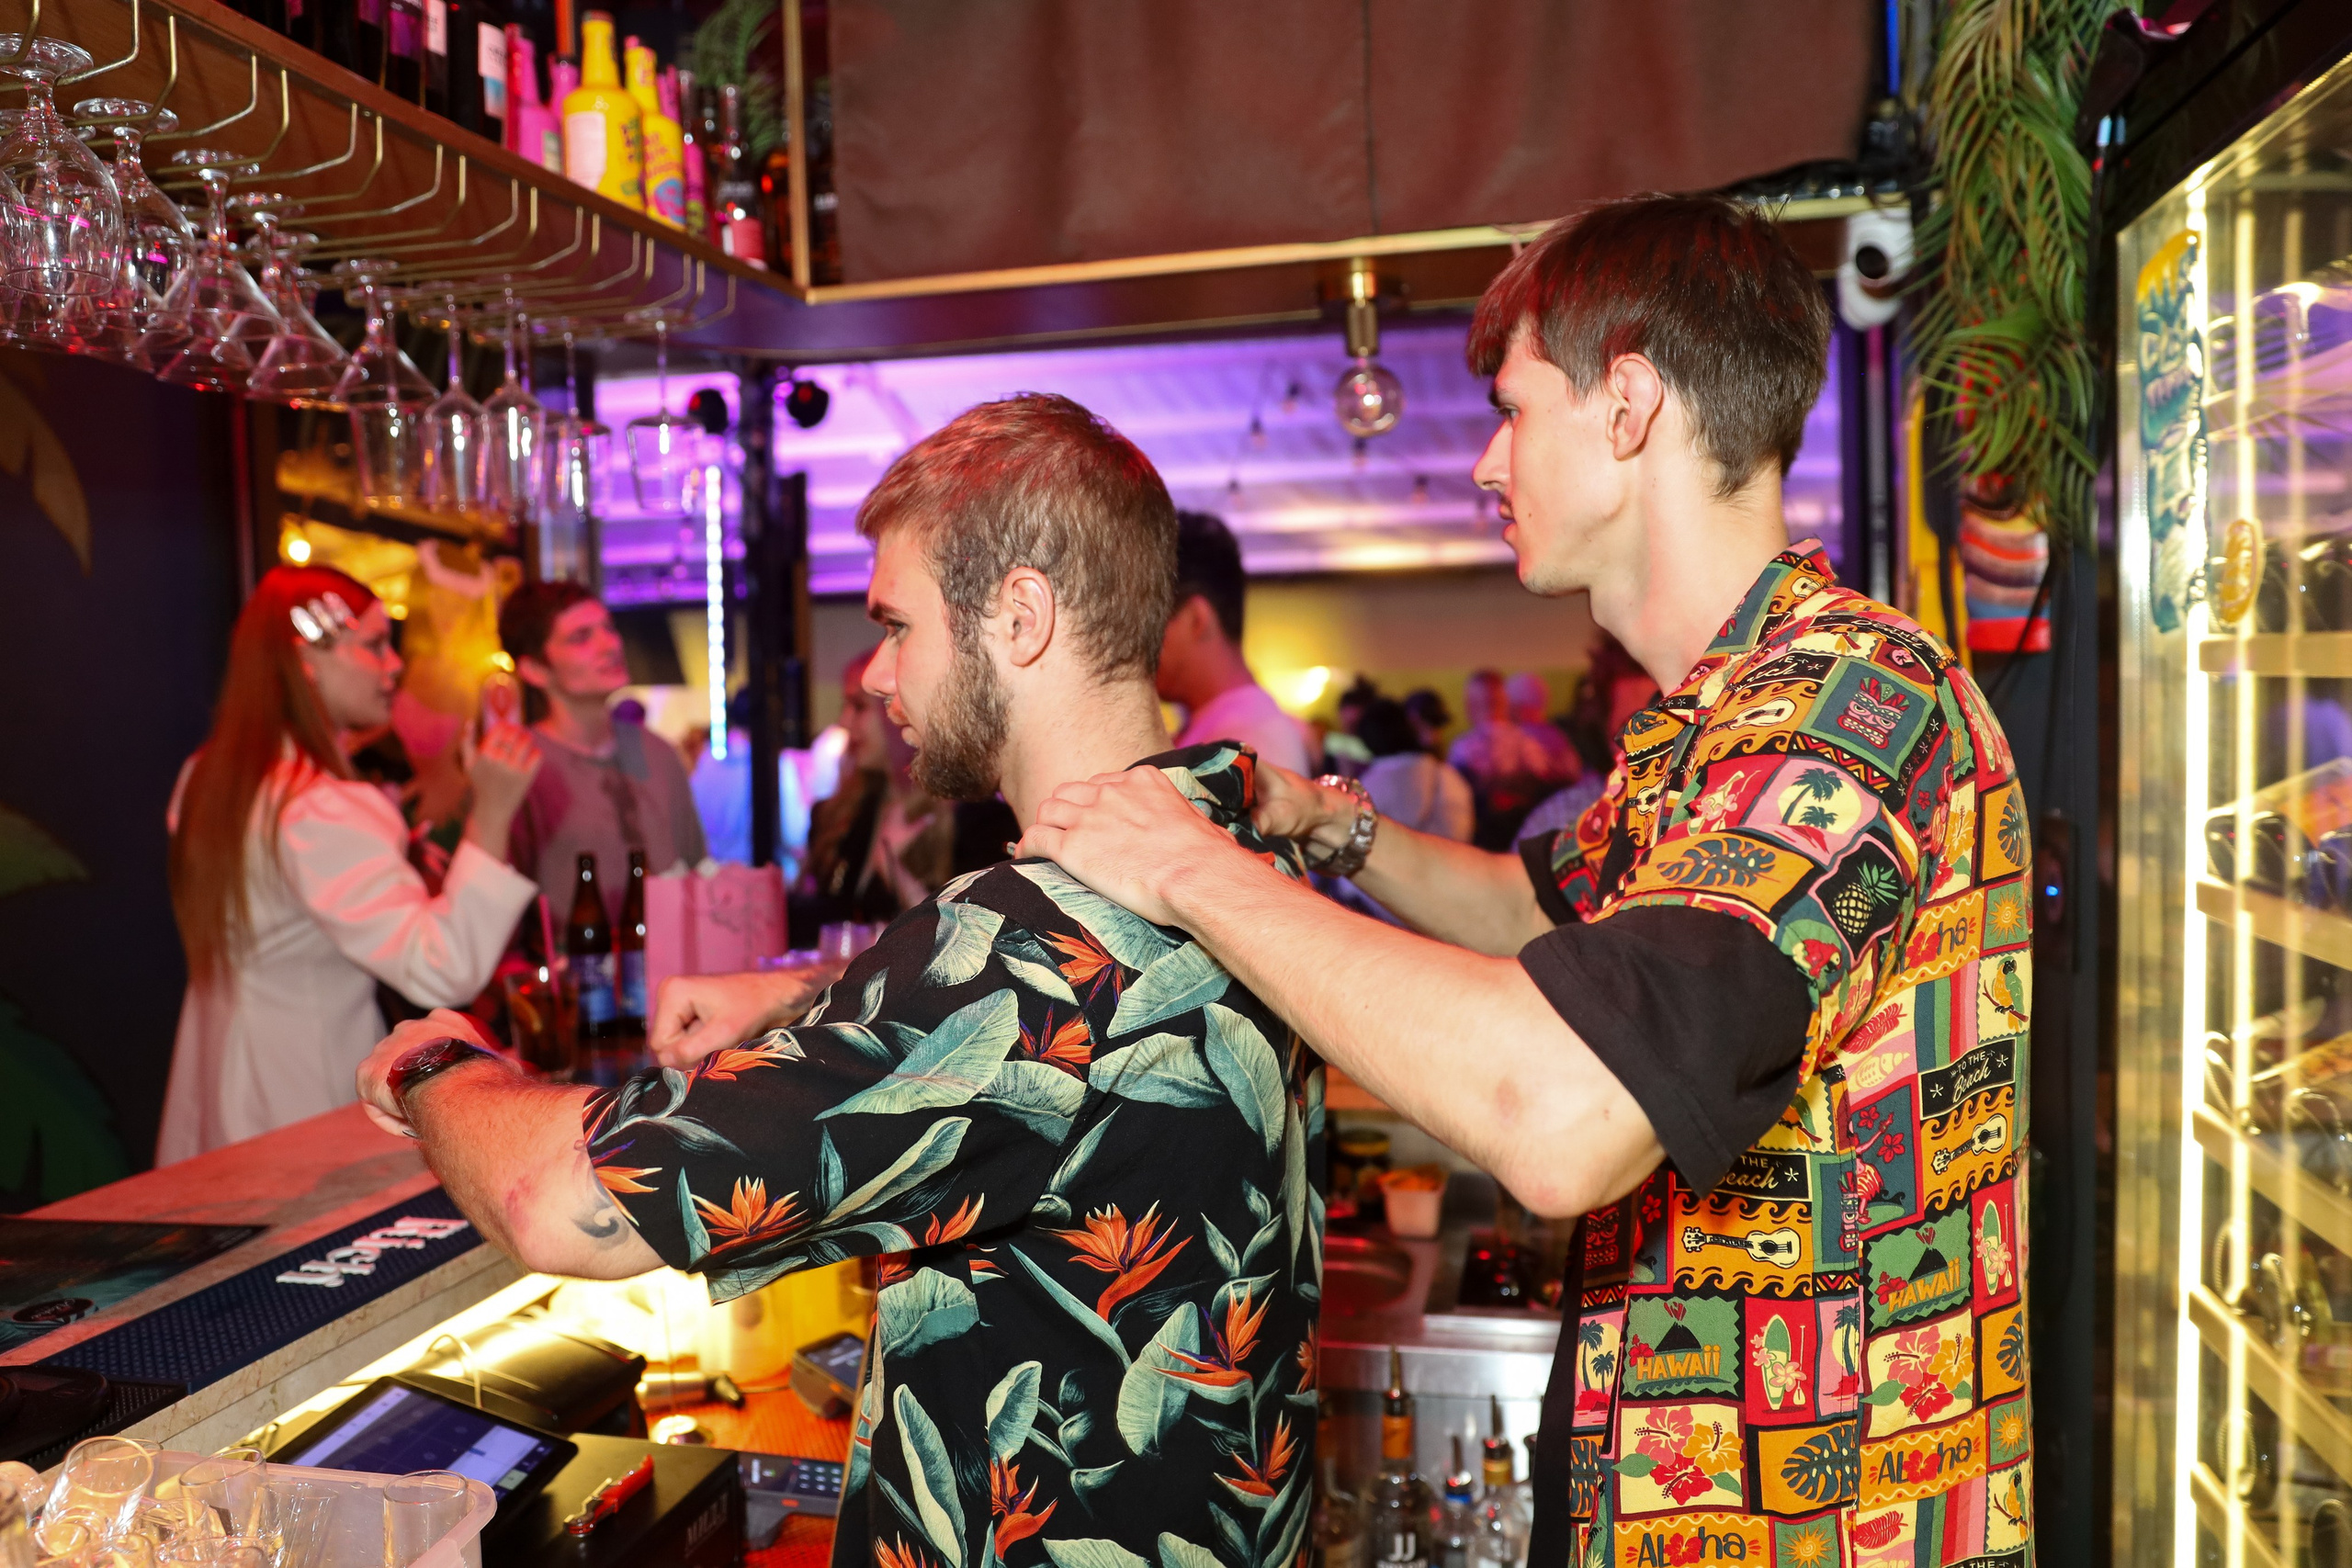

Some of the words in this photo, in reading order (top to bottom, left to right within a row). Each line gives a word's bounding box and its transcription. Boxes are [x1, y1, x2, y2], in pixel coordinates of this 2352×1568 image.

[1958, 1061, 1967, 1073] TO
[1968, 1051, 1986, 1066] THE
[1952, 1057, 1992, 1103] Beach
[1740, 1155, 1769, 1168] THE
[1716, 1167, 1780, 1190] each
